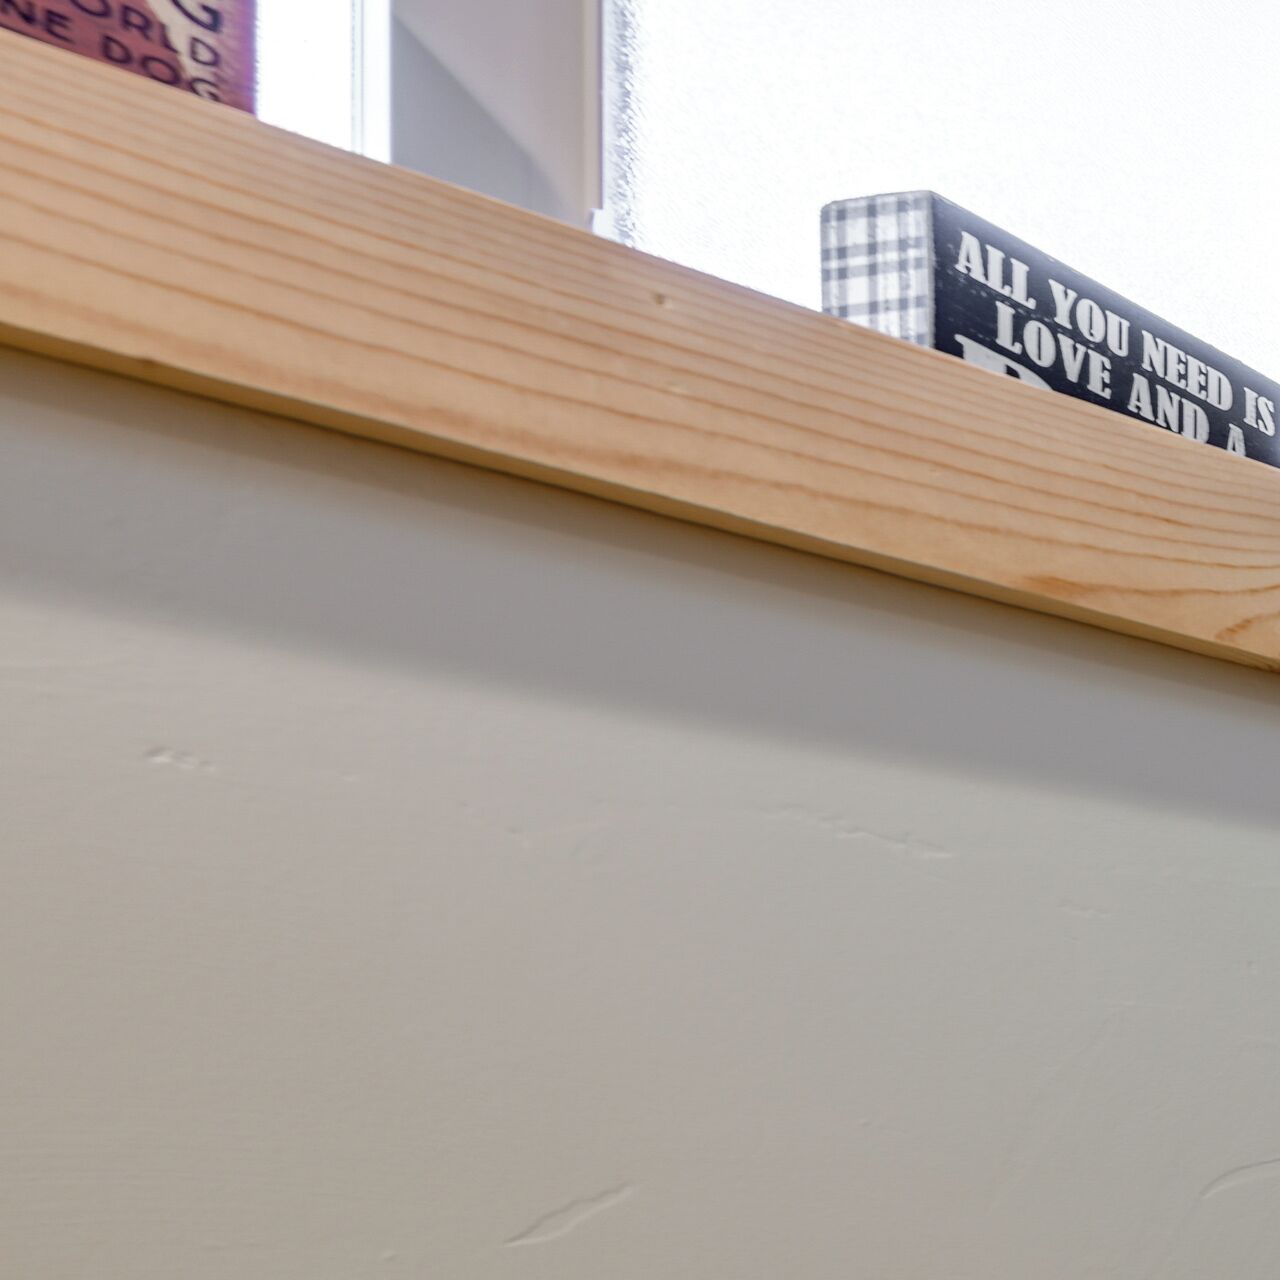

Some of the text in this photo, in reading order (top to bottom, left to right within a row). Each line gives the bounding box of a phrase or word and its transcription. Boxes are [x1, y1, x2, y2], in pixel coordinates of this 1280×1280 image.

[101, 35, 221, 102] DOG
[954, 231, 1037, 310] ALL
[1048, 278, 1132, 358] YOU
[1141, 329, 1234, 412] NEED
[1243, 386, 1276, 438] IS
[995, 300, 1112, 400] LOVE
[1127, 372, 1211, 445] AND
[1226, 423, 1247, 457] A
